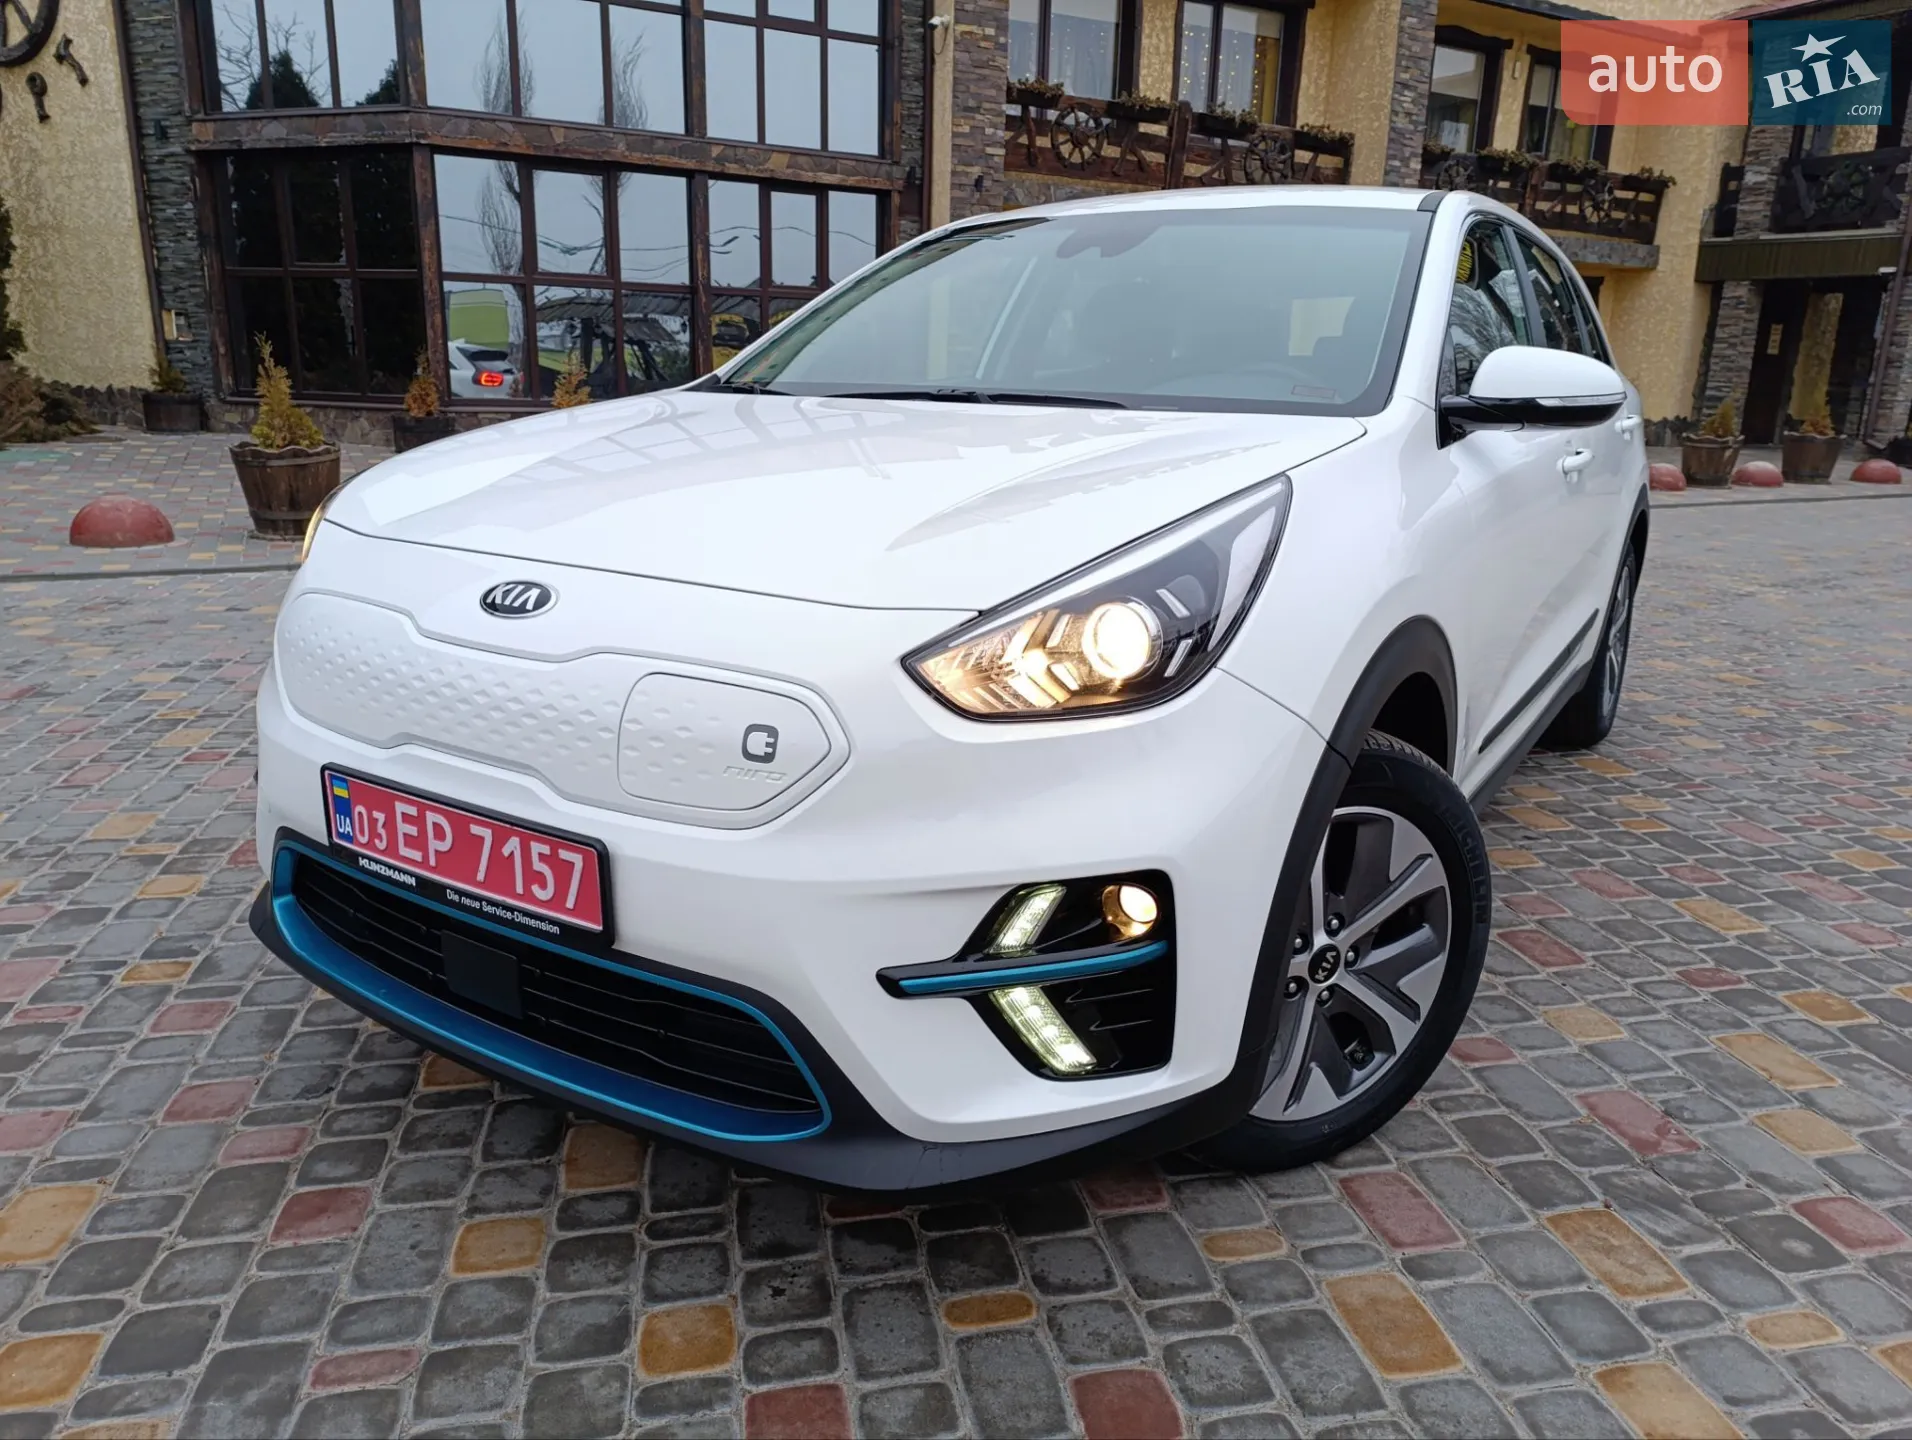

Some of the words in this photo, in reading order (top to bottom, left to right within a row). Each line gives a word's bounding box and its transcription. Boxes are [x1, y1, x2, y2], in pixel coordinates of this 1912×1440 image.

[486, 583, 541, 611] KIA
[336, 813, 353, 836] UA
[354, 804, 388, 850] 03
[394, 800, 453, 867] EP
[469, 823, 584, 910] 7157
[358, 856, 416, 887] KUNZMANN
[446, 888, 460, 903] Die
[460, 895, 481, 909] neue
[481, 901, 560, 935] Service-Dimension
[1314, 951, 1337, 981] KIA
